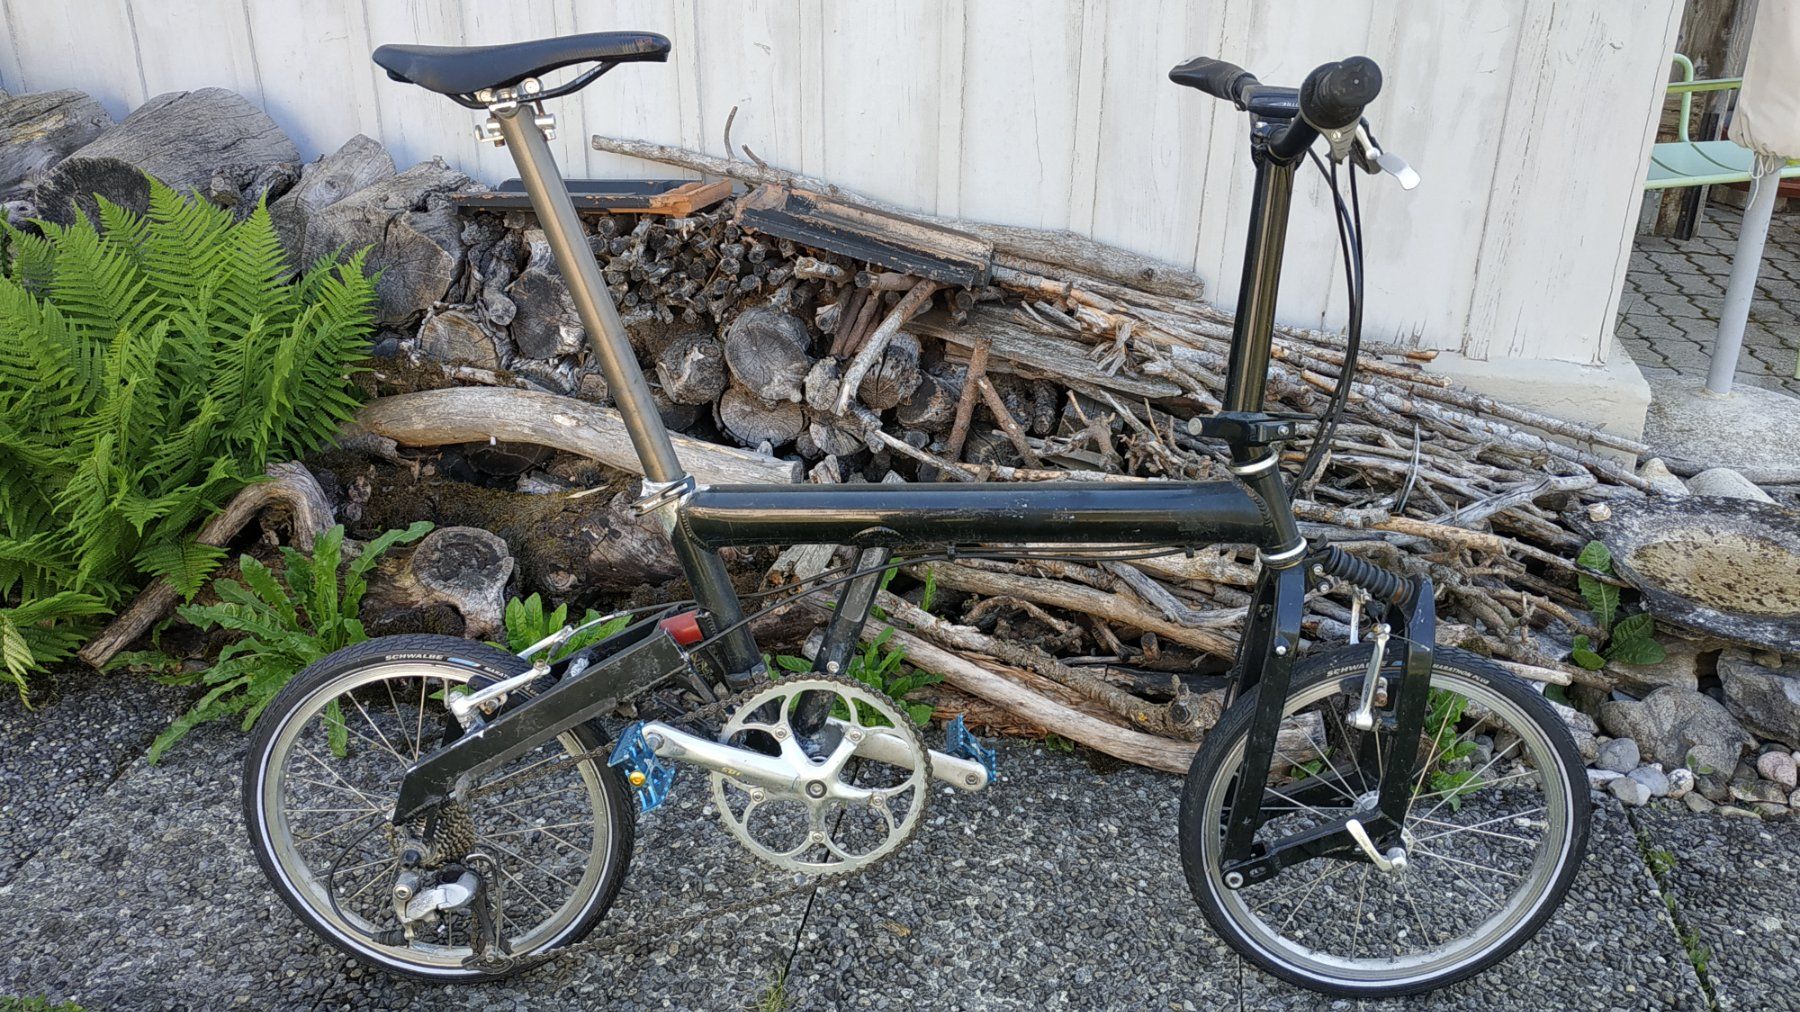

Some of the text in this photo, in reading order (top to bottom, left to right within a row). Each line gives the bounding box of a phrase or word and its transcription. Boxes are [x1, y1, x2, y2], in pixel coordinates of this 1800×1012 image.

[385, 653, 444, 661] SCHWALBE
[1326, 661, 1388, 677] SCHWAE
[1432, 663, 1472, 677] MARATHON
